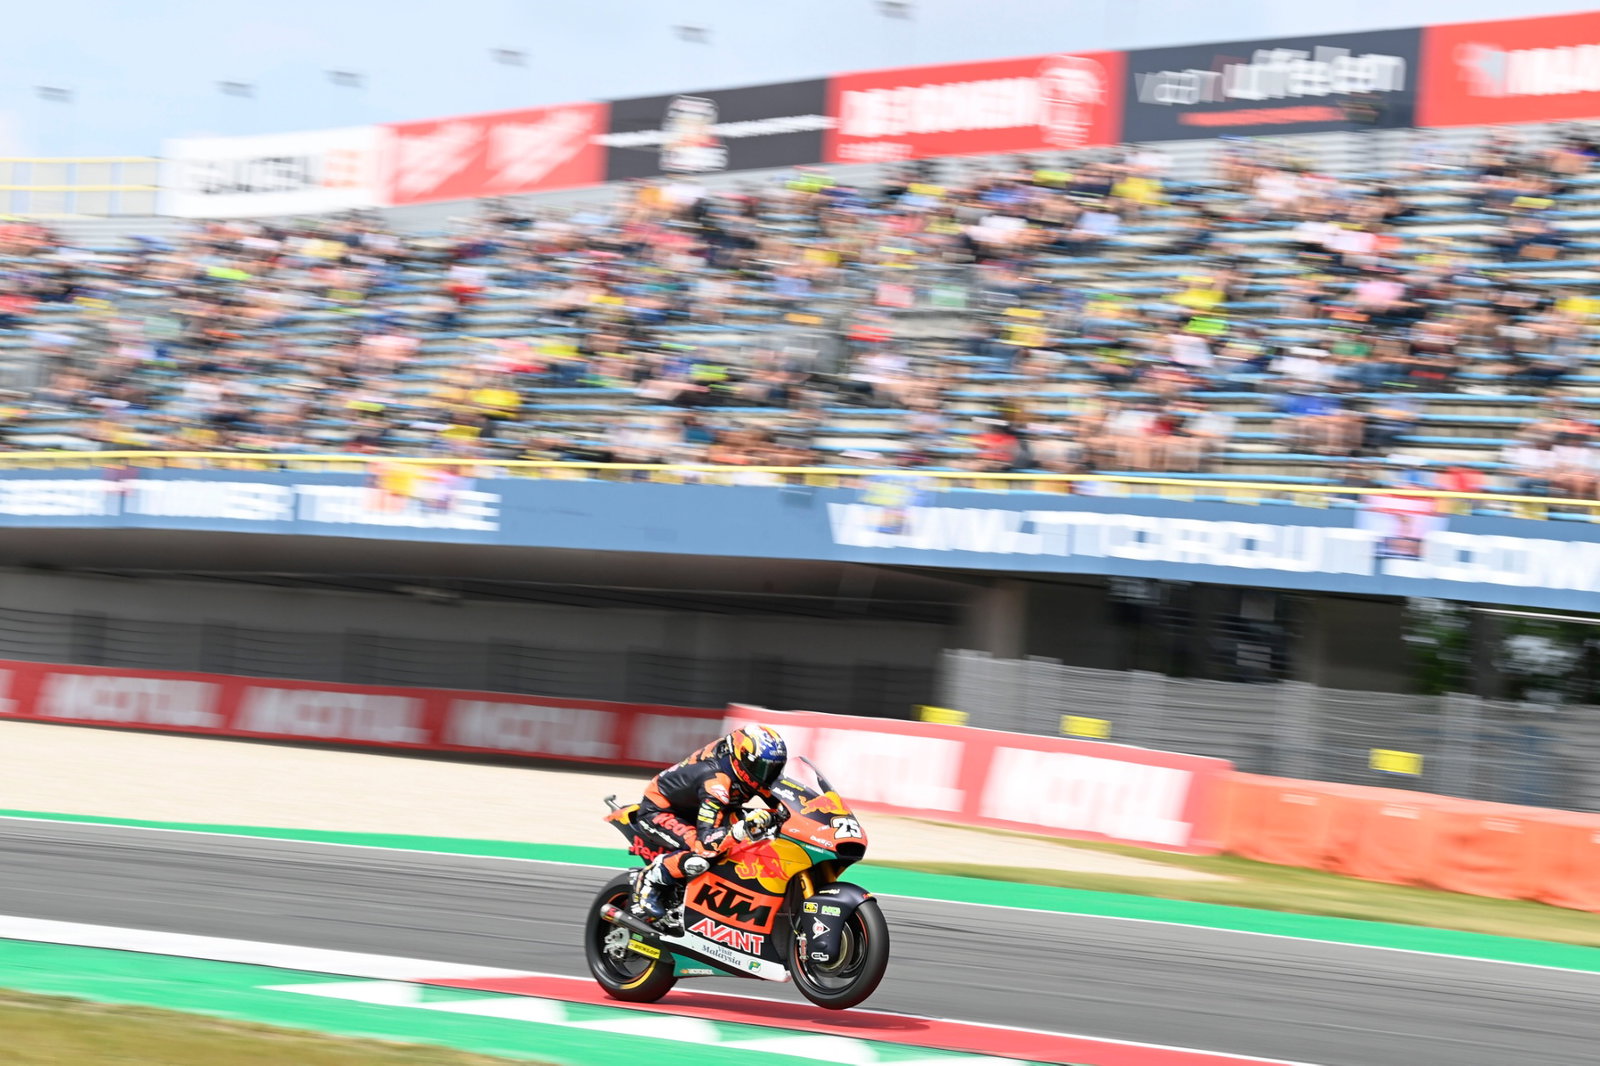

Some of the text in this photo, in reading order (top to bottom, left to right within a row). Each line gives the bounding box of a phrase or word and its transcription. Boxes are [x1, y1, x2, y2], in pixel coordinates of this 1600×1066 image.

[831, 816, 863, 840] 25
[692, 881, 772, 927] KTM
[688, 917, 764, 956] AVANT
[701, 944, 742, 966] Malaysia
